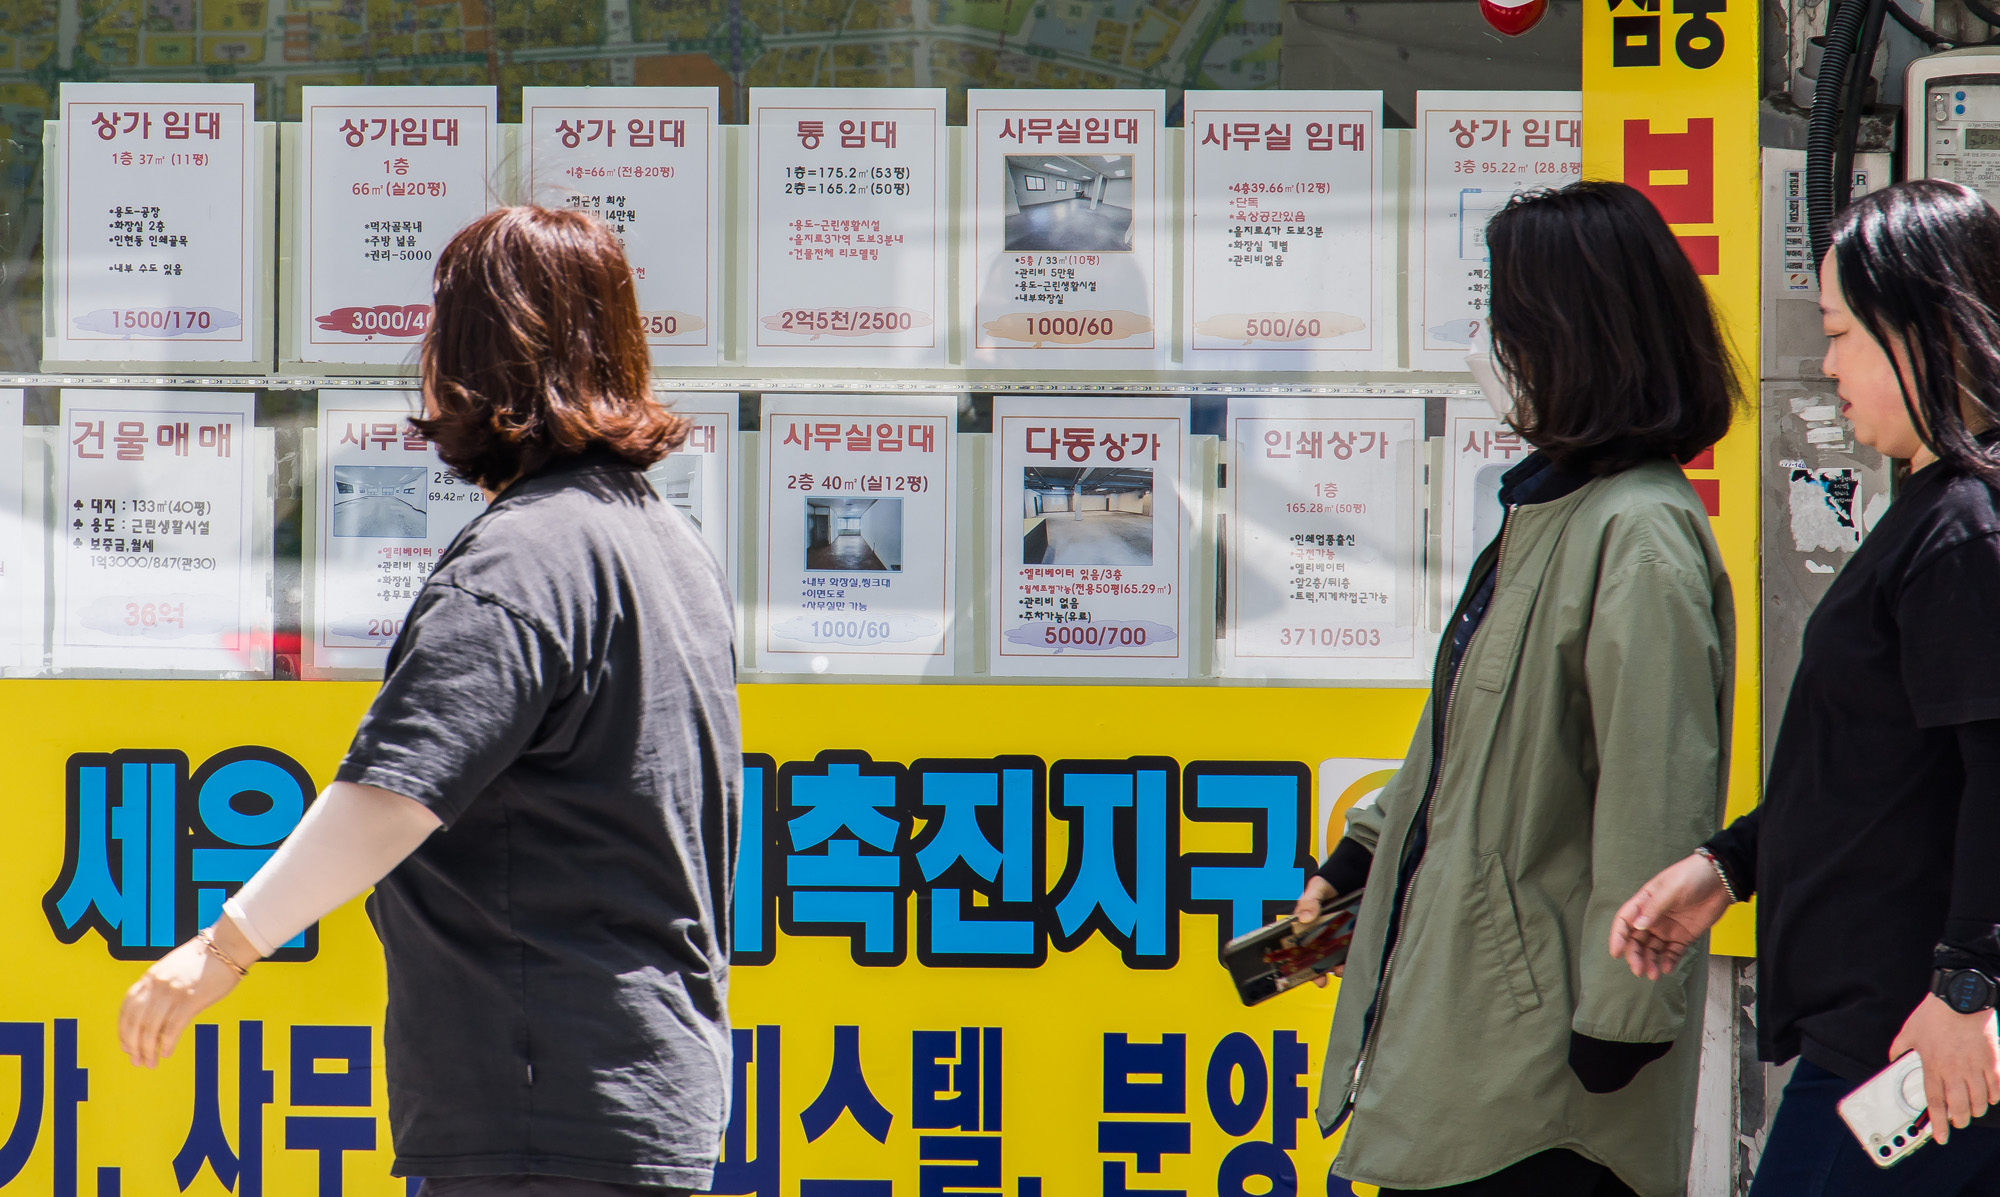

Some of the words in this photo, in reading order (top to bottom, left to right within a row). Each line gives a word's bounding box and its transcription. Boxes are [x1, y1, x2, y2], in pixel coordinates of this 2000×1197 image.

[92, 112, 152, 140] 상가
[163, 111, 220, 139] 임대
[999, 118, 1138, 144] 사무실임대
[339, 118, 458, 147] 상가임대
[556, 119, 616, 148] 상가
[627, 119, 685, 147] 임대
[797, 120, 825, 150] 통
[839, 120, 897, 149] 임대
[1202, 123, 1291, 151] 사무실
[1306, 122, 1364, 151] 임대
[1449, 119, 1511, 148] 상가
[1522, 119, 1582, 147] 임대
[112, 151, 133, 166] 1층
[171, 153, 209, 166] (11평)
[384, 157, 409, 176] 1층
[1454, 160, 1476, 174] 3층
[1534, 161, 1582, 175] (28.8평
[1236, 197, 1259, 208] 단독
[114, 206, 160, 218] 용도-공장
[605, 210, 636, 222] 14만원
[1236, 211, 1306, 222] 옥상공간있음
[114, 221, 143, 233] 화장실
[149, 221, 165, 233] 2층
[370, 221, 423, 233] 먹자골목내
[794, 220, 880, 231] 용도-근린생활시설
[1233, 226, 1281, 238] 을지로4가
[1286, 226, 1324, 238] 도보3분
[114, 235, 143, 247] 인현동
[149, 235, 189, 247] 인쇄골목
[370, 235, 391, 247] 주방
[396, 235, 417, 247] 넓음
[794, 234, 851, 246] 을지로3가역
[856, 234, 904, 246] 도보3분내
[1233, 240, 1263, 252] 화장실
[1269, 240, 1288, 252] 개별
[370, 250, 433, 262] 권리-5000
[794, 249, 834, 260] 건물전체
[839, 249, 879, 260] 리모델링
[1020, 255, 1034, 266] 5층
[1233, 255, 1284, 266] 관리비없음
[114, 263, 133, 273] 내부
[139, 263, 158, 273] 수도
[163, 264, 183, 276] 있음
[1019, 268, 1046, 279] 관리비
[1051, 268, 1075, 279] 5만원
[1019, 281, 1097, 292] 용도-근린생활시설
[1019, 294, 1064, 304] 내부화장실
[112, 311, 211, 329] 1500/170
[781, 310, 912, 331] 2억5천/2500
[1026, 317, 1113, 336] 1000/60
[1246, 318, 1321, 337] 500/60
[73, 421, 231, 461] 건물매매
[340, 423, 439, 451] 사무실
[783, 423, 934, 452] 사무실임대
[1026, 428, 1161, 462] 다동상가
[1264, 430, 1389, 460] 인쇄상가
[1463, 431, 1539, 459] 사무
[434, 472, 455, 485] 2층
[787, 473, 815, 491] 2층
[1314, 482, 1338, 498] 1층
[469, 492, 485, 503] (21
[91, 499, 116, 514] 대지
[91, 518, 115, 533] 용도
[132, 519, 210, 536] 근린생활시설
[90, 538, 154, 552] 보증금,월세
[382, 547, 432, 558] 엘리베이터
[382, 561, 412, 573] 관리비
[417, 562, 439, 573] 월5
[1295, 563, 1345, 575] 엘리베이터
[1024, 568, 1074, 580] 엘리베이터
[1080, 569, 1122, 581] 있음/3층
[382, 576, 411, 587] 화장실
[806, 577, 826, 587] 내부
[806, 589, 845, 598] 이면도로
[1295, 592, 1388, 604] 트럭,지게차접근가능
[806, 601, 845, 611] 사무실만
[849, 602, 868, 611] 가능
[1024, 597, 1054, 609] 관리비
[1059, 597, 1079, 609] 없음
[124, 602, 184, 629] 36억
[1024, 611, 1092, 623] 주차가능(유료)
[811, 620, 890, 639] 1000/60
[1044, 626, 1146, 646] 5000/700
[1280, 627, 1381, 647] 3710/503
[42, 745, 319, 962] 세운
[172, 1020, 424, 1197] 사무
[1098, 1031, 1380, 1197] 분양
